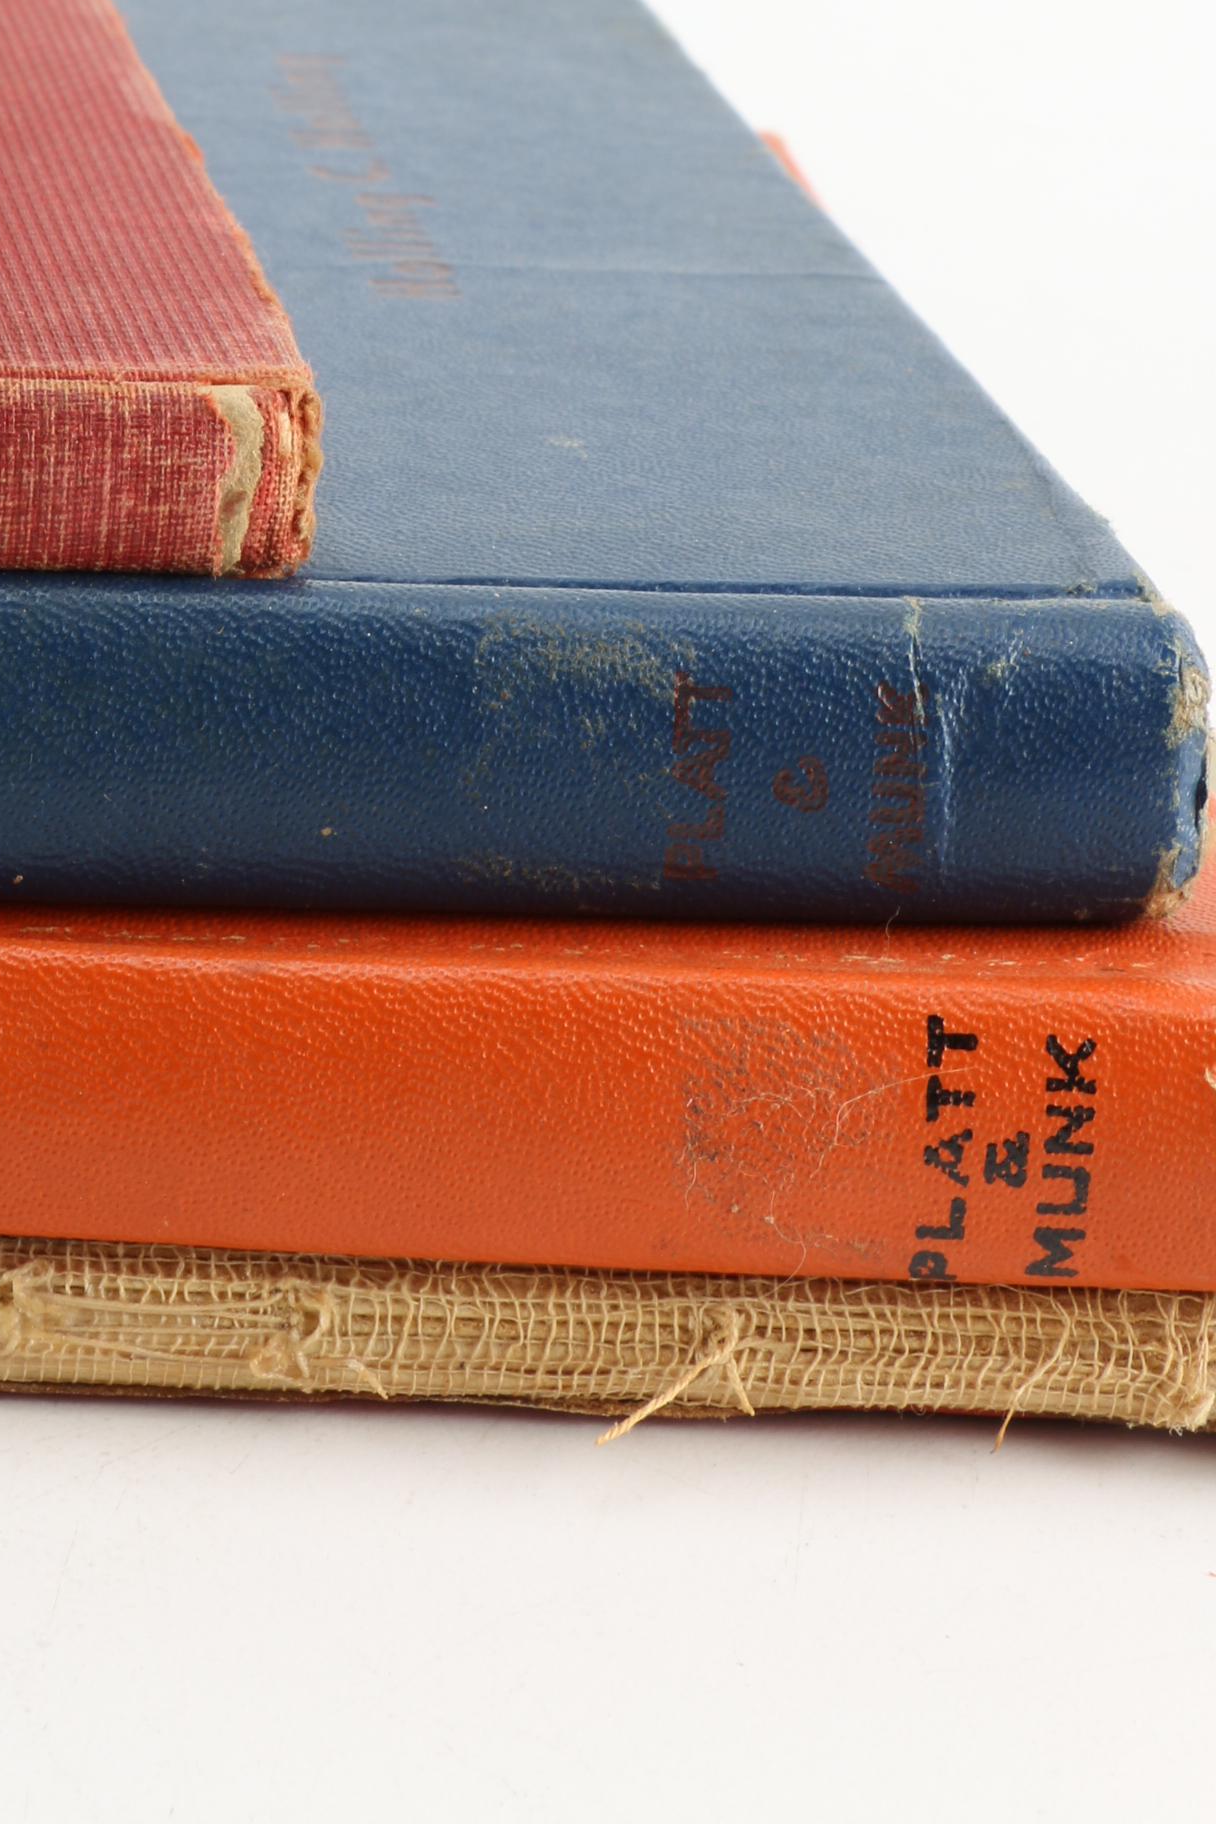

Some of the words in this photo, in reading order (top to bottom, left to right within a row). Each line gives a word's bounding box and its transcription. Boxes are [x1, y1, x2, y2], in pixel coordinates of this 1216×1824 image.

[664, 671, 733, 881] PLATT
[862, 682, 930, 896] MUNK
[907, 1013, 978, 1282] PLATT
[983, 1132, 1029, 1188] &
[1024, 1034, 1096, 1279] MUNK
